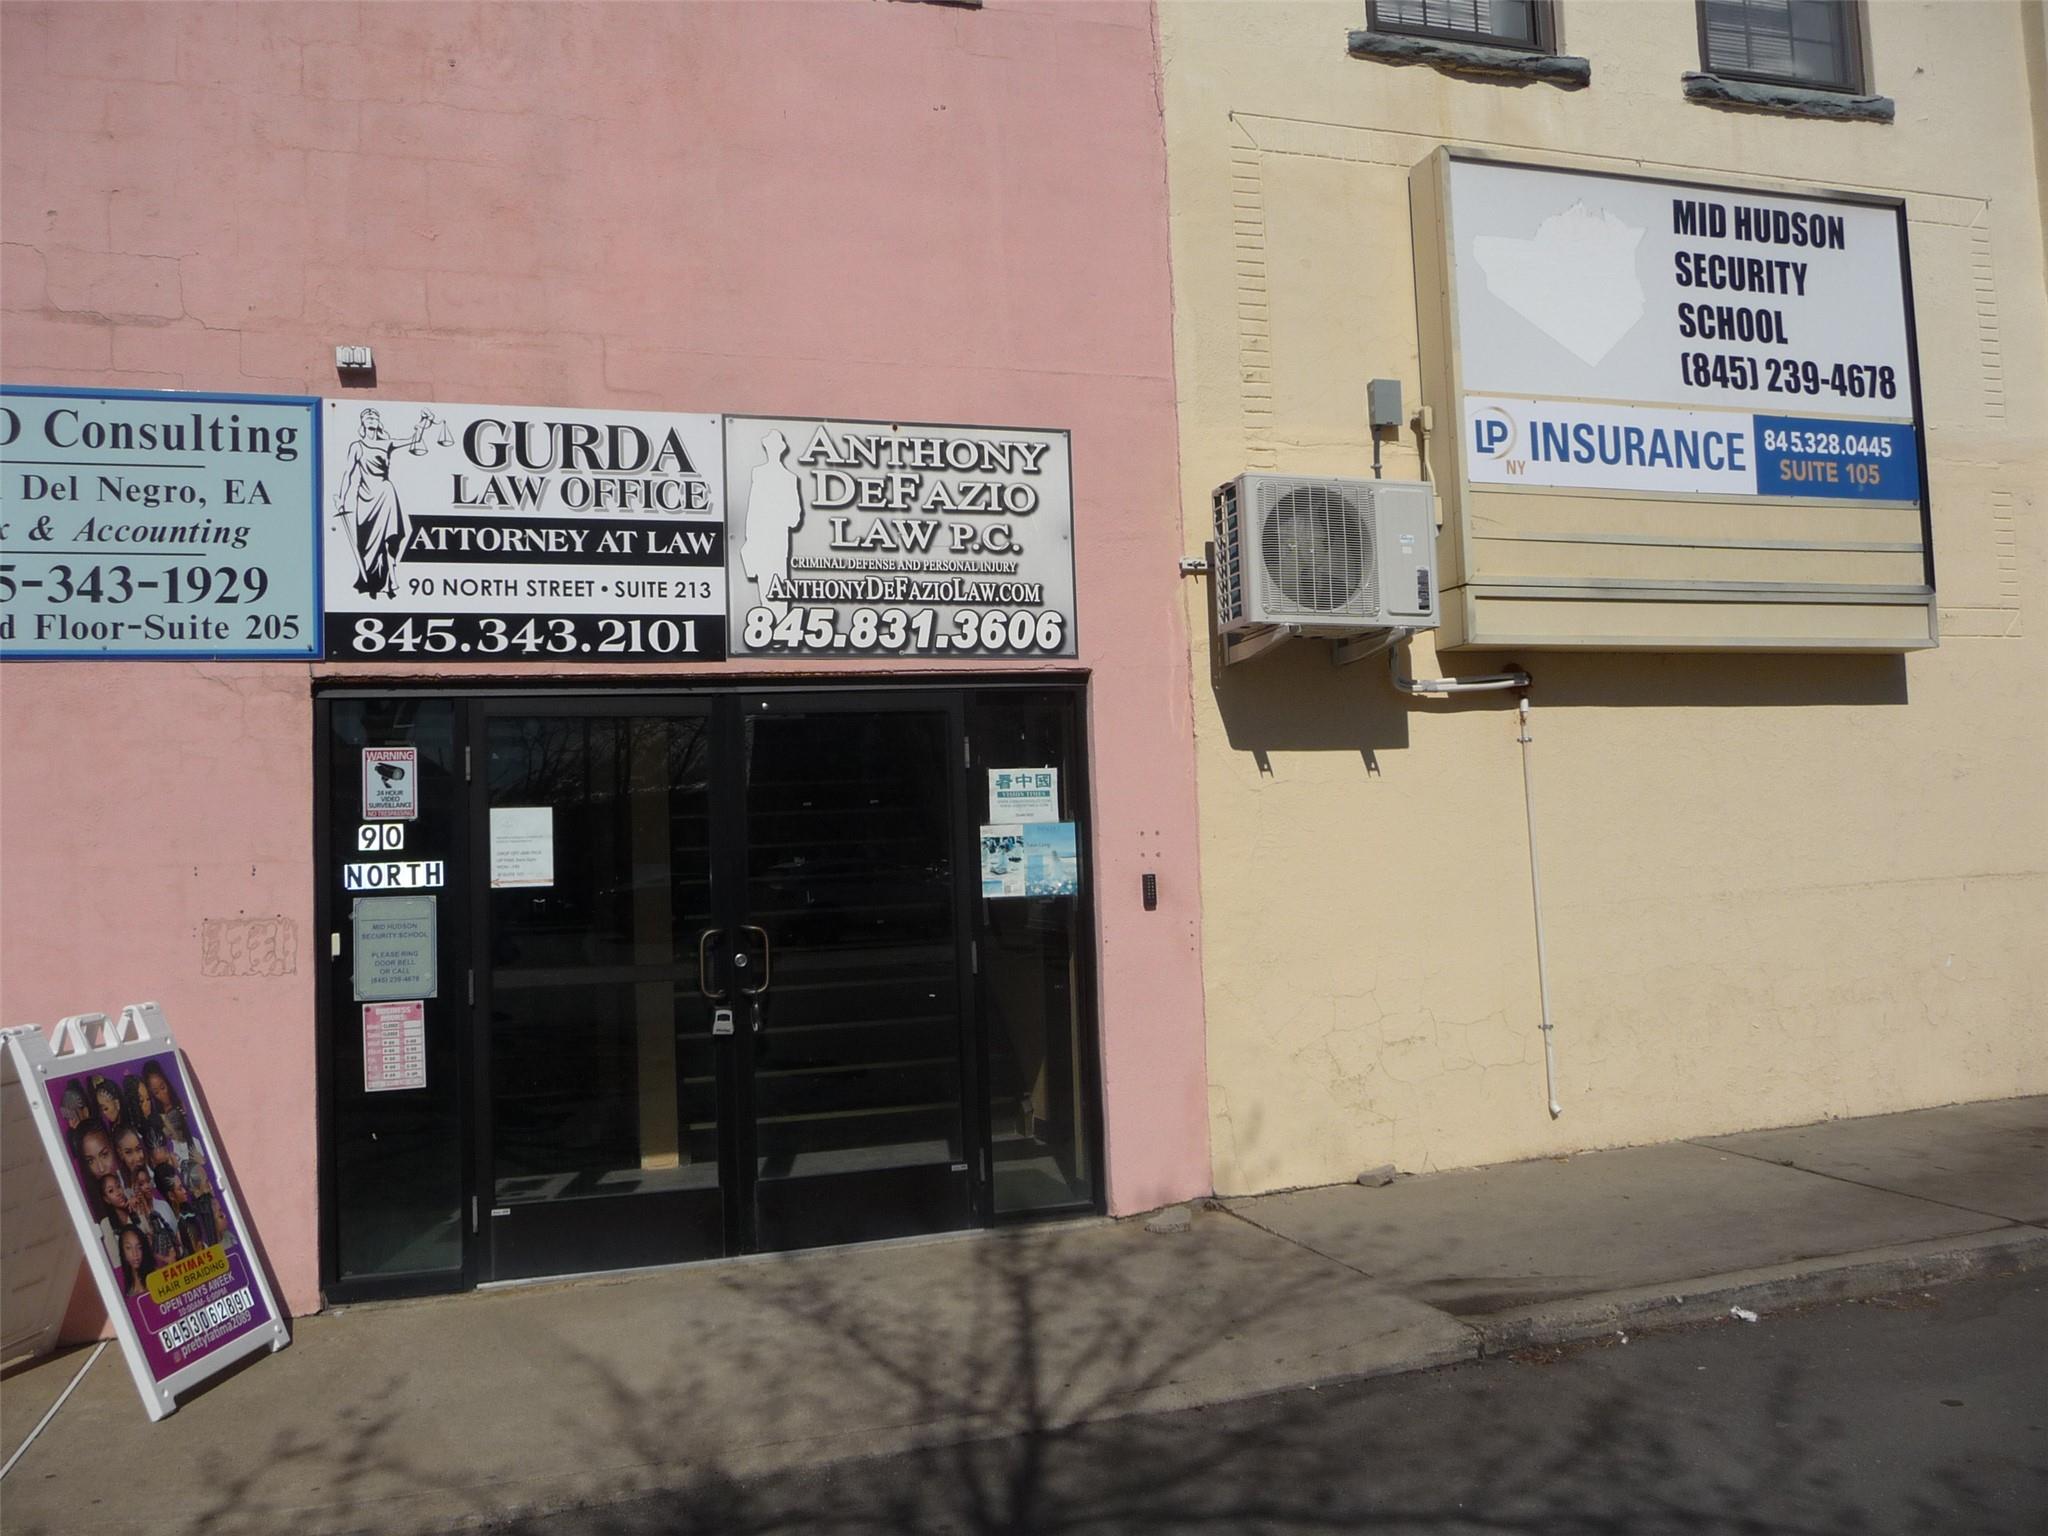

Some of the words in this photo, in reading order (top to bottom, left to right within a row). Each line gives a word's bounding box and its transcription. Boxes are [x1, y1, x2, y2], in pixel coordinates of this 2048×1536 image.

[1672, 199, 1728, 239] MID
[1733, 206, 1846, 251] HUDSON
[1674, 251, 1808, 297] SECURITY
[1677, 302, 1789, 345] SCHOOL
[1680, 352, 1760, 391] (845)
[1764, 357, 1897, 400] 239-4678
[44, 407, 299, 462] Consulting
[462, 418, 702, 476] GURDA
[799, 424, 1048, 472] ANTHONY
[1475, 419, 1508, 453] LP
[1529, 420, 1746, 471] INSURANCE
[1506, 460, 1526, 475] NY
[1780, 458, 1839, 482] SUITE
[1846, 463, 1880, 485] 105
[21, 474, 79, 501] Del
[98, 476, 206, 508] Negro,
[224, 479, 273, 505] EA
[452, 474, 546, 510] LAW
[560, 476, 712, 514] OFFICE
[811, 468, 1038, 514] DEFAZIO
[29, 515, 54, 542] &
[72, 516, 251, 549] Accounting
[410, 527, 590, 554] ATTORNEY
[596, 530, 637, 555] AT
[647, 531, 717, 556] LAW
[830, 517, 938, 551] LAW
[950, 523, 1023, 553] P.C.
[790, 556, 847, 570] CRIMINAL
[848, 558, 897, 571] DEFENSE
[898, 558, 921, 571] AND
[923, 559, 979, 573] PERSONAL
[980, 560, 1018, 574] INJURY
[408, 578, 435, 597] 90
[443, 577, 518, 598] NORTH
[526, 578, 595, 598] STREET
[615, 580, 667, 599] SUITE
[675, 581, 712, 599] 213
[767, 573, 1042, 603] ANTHONYDEFAZIOLAW.COM
[34, 613, 230, 641] Floor-Suite
[246, 614, 300, 640] 205
[352, 617, 700, 653] 845.343.2101
[744, 606, 1064, 650] 845.831.3606
[366, 751, 414, 761] WARNING
[361, 826, 402, 849] 90
[347, 863, 441, 888] NORTH
[362, 932, 398, 940] SECURITY
[392, 967, 410, 975] CALL
[157, 1281, 180, 1297] HAIR
[184, 1260, 225, 1285] BRAIDING
[162, 1251, 213, 1280] FATIMA'S
[160, 1300, 183, 1315] OPEN
[162, 1290, 252, 1349] 8453062891
